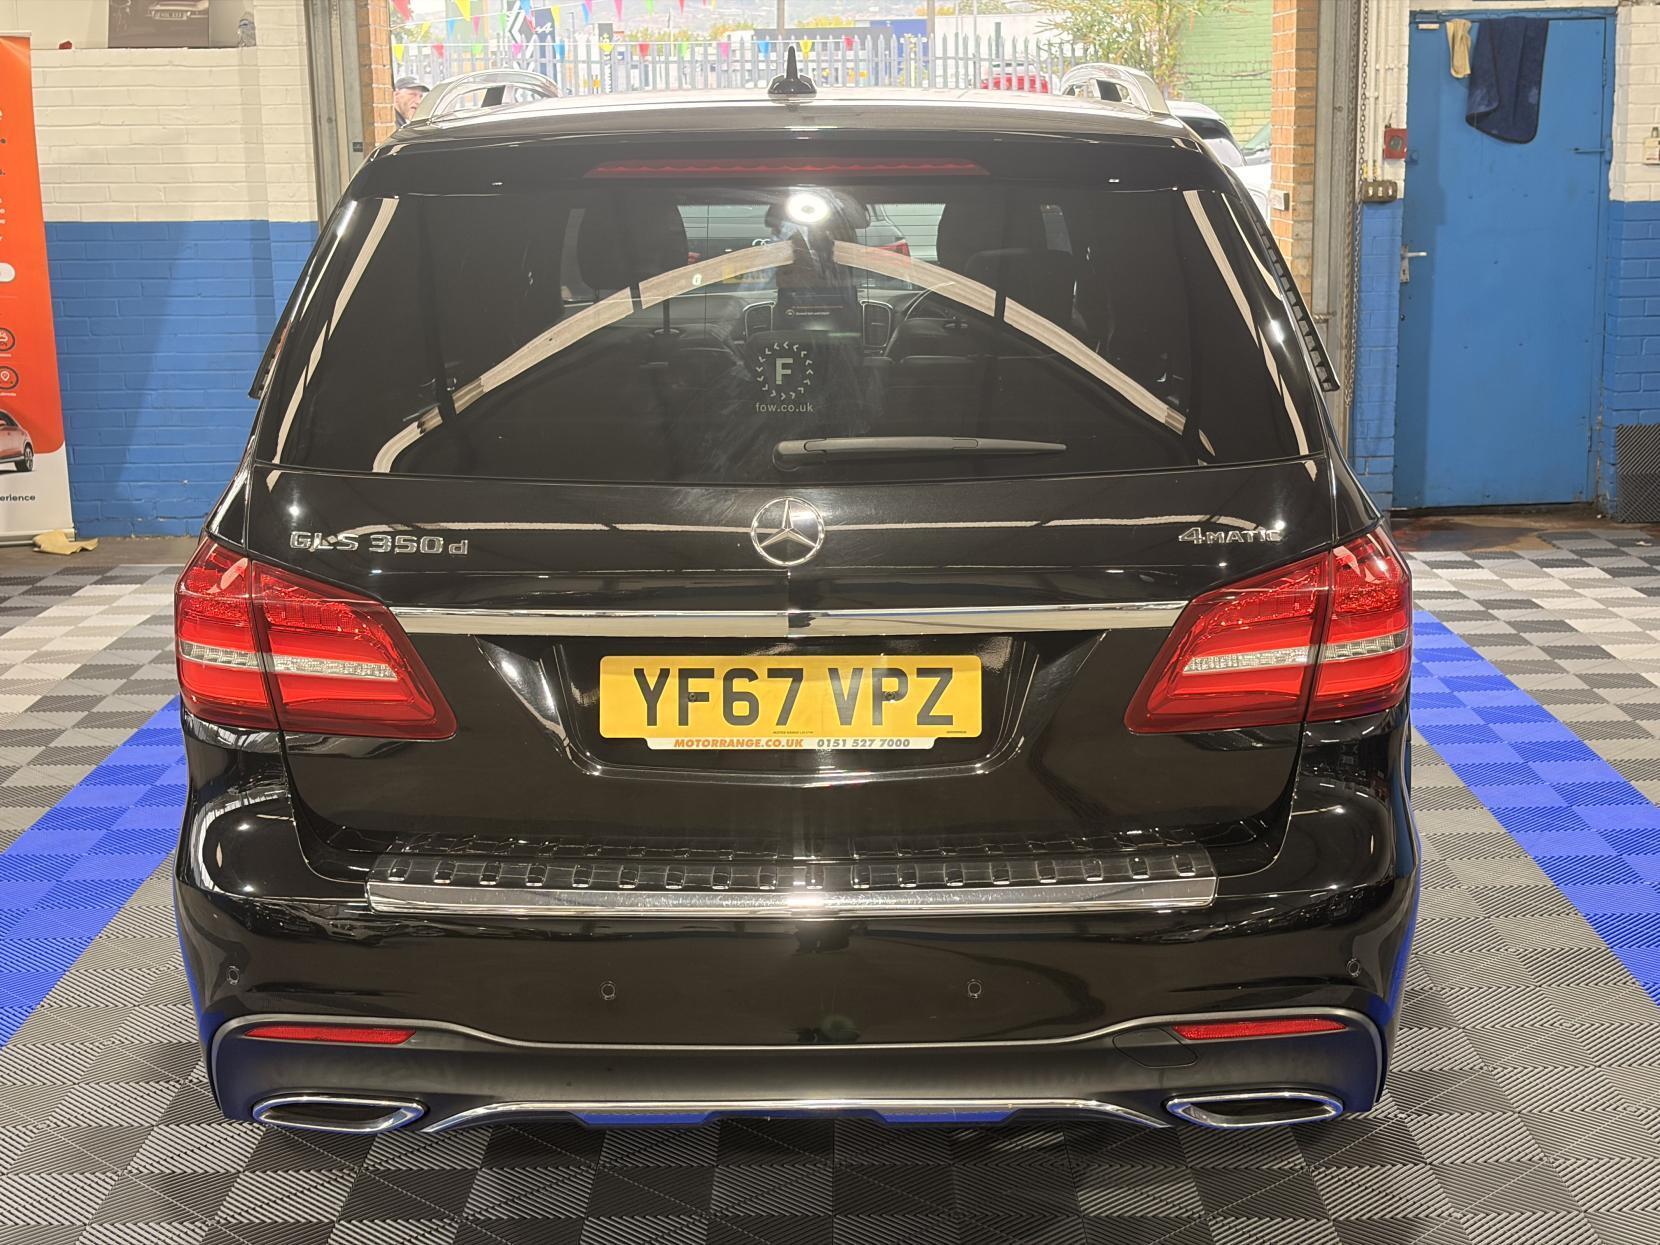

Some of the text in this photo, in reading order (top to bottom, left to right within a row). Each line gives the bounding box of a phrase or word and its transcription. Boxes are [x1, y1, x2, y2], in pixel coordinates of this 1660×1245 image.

[290, 531, 359, 551] GLS
[633, 667, 954, 727] YF67 VPZ
[674, 738, 911, 748] MOTORRANGE.CO.UK 0151 527 7000
